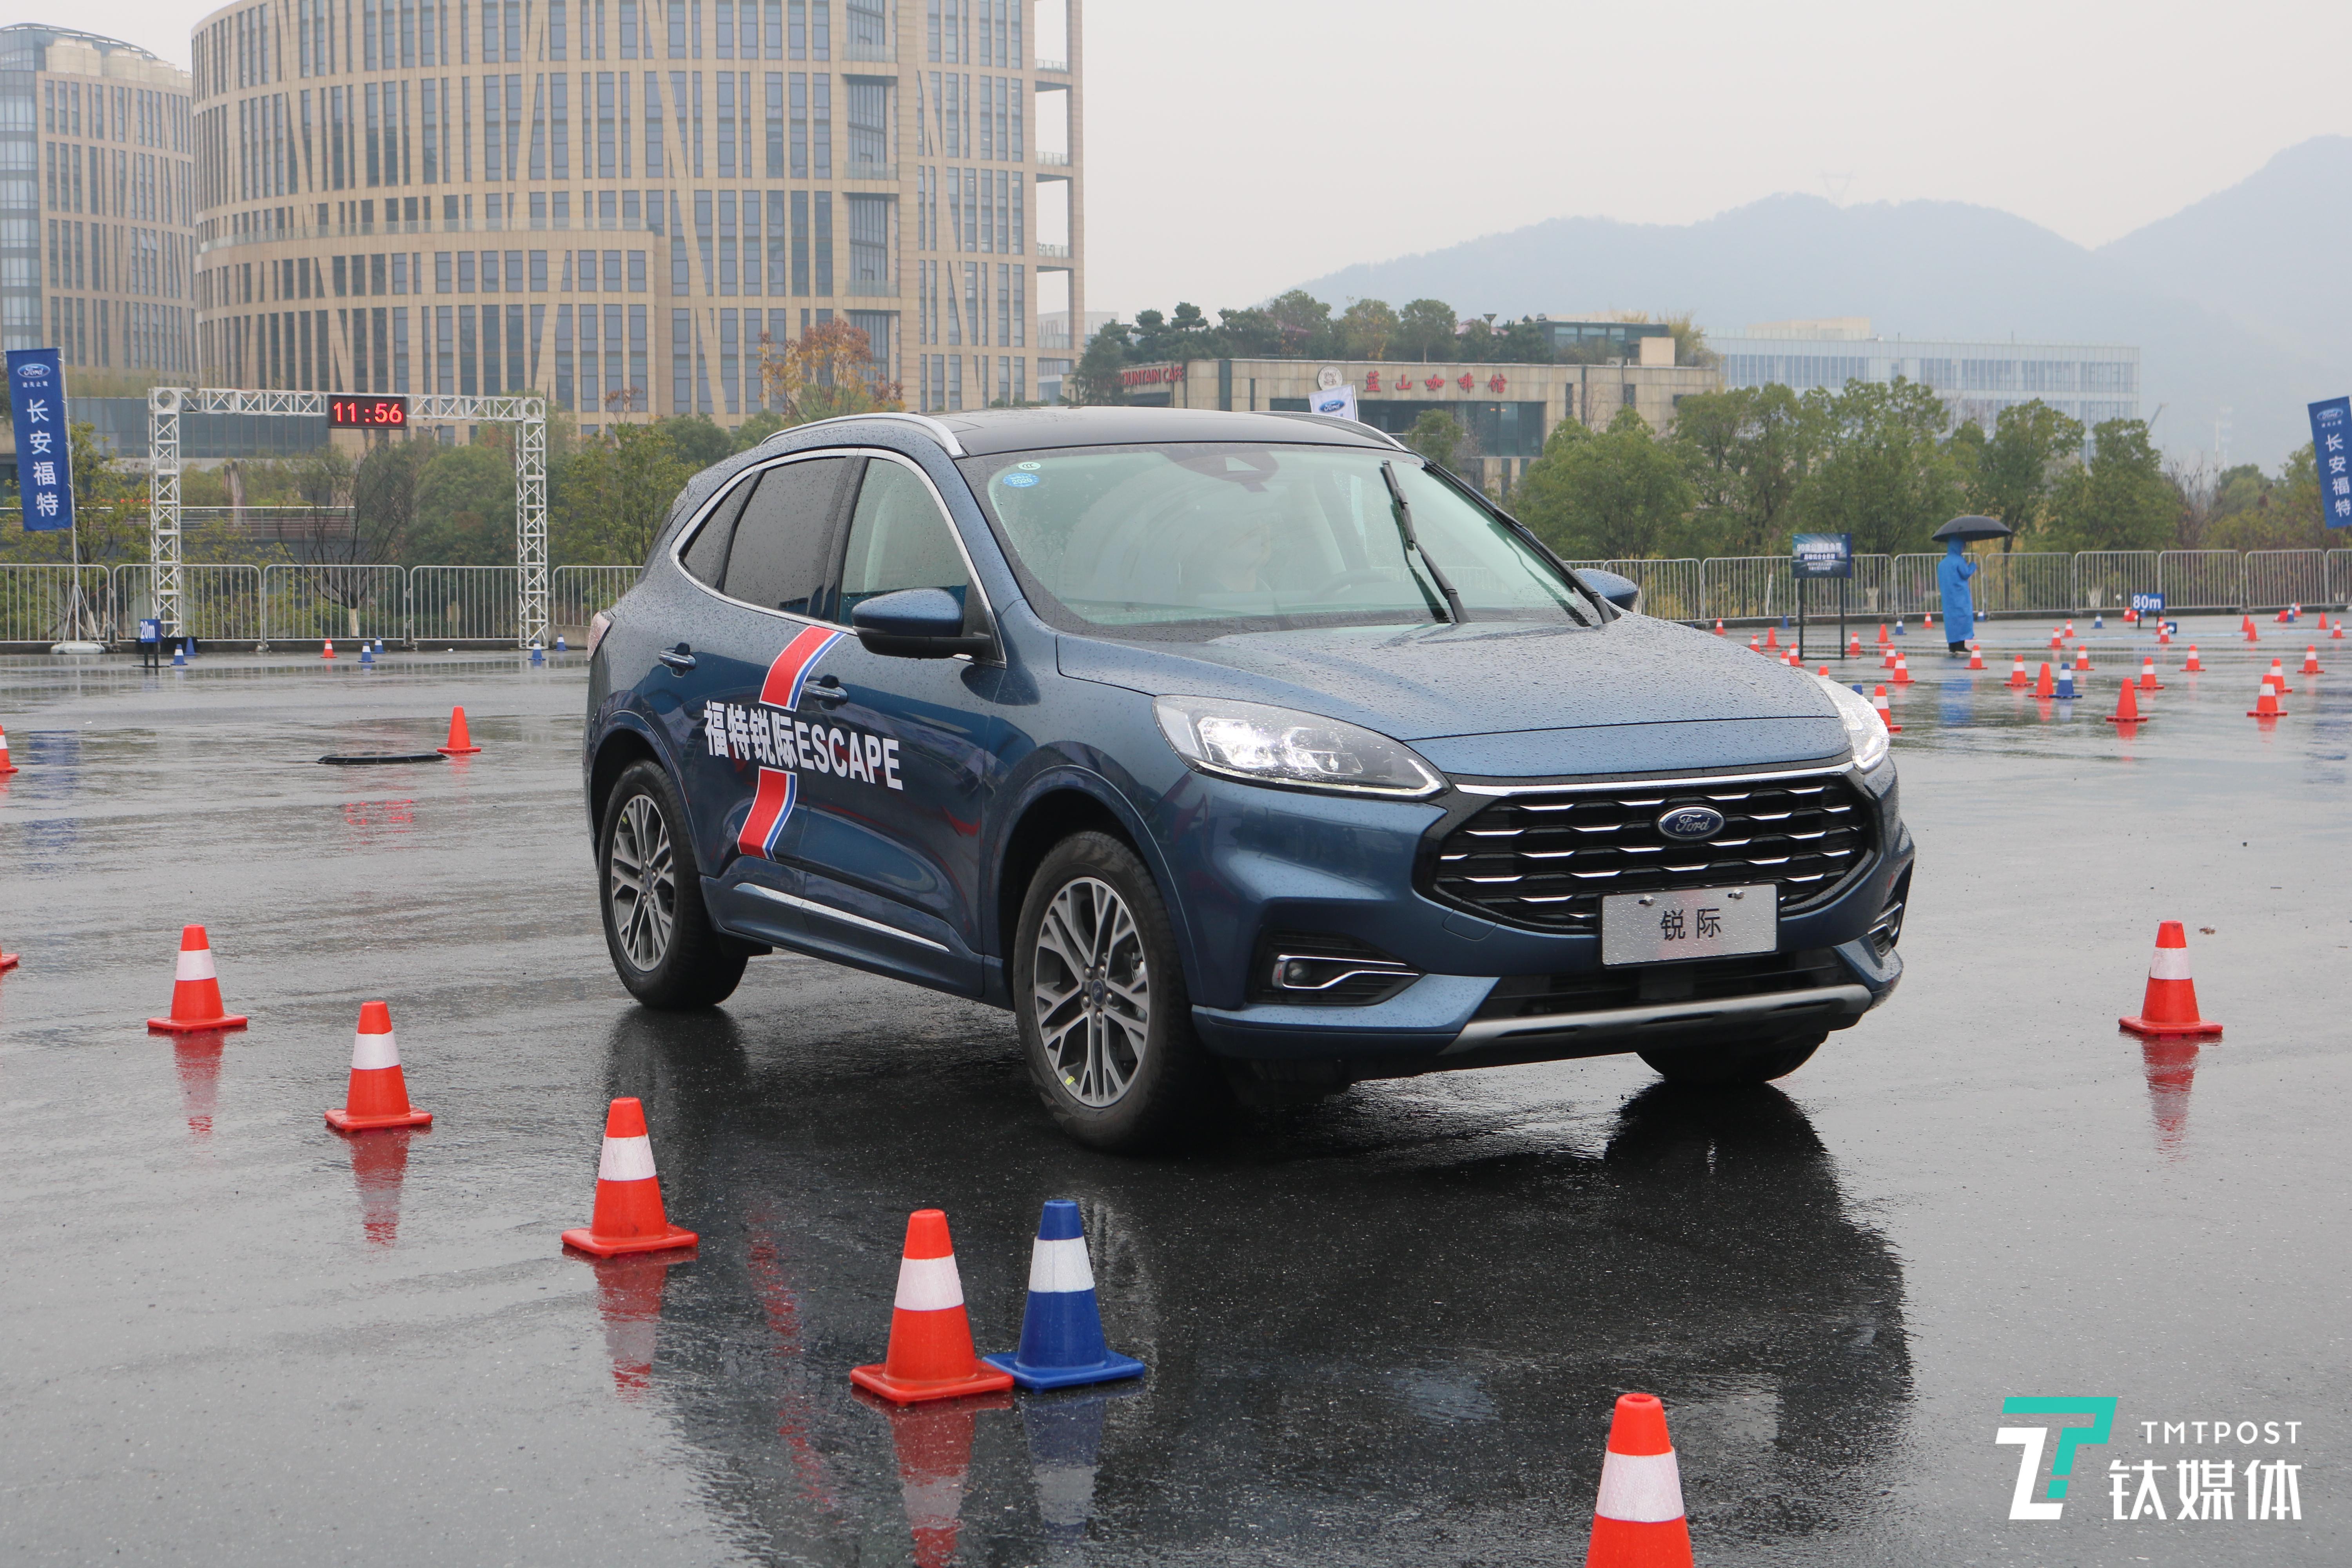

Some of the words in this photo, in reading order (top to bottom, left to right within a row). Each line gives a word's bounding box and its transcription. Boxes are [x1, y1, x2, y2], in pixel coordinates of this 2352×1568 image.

[24, 365, 44, 376] Ford
[1162, 366, 1184, 383] CAFE
[1364, 370, 1507, 392] 蓝山咖啡馆
[334, 402, 403, 423] 11:56
[1324, 401, 1340, 412] Ford
[27, 399, 58, 517] 长安福特
[2325, 433, 2351, 517] 长安福特
[2133, 595, 2161, 609] 80m
[140, 621, 155, 639] 20m
[1675, 813, 1711, 833] Ford
[1660, 907, 1721, 941] 锐际
